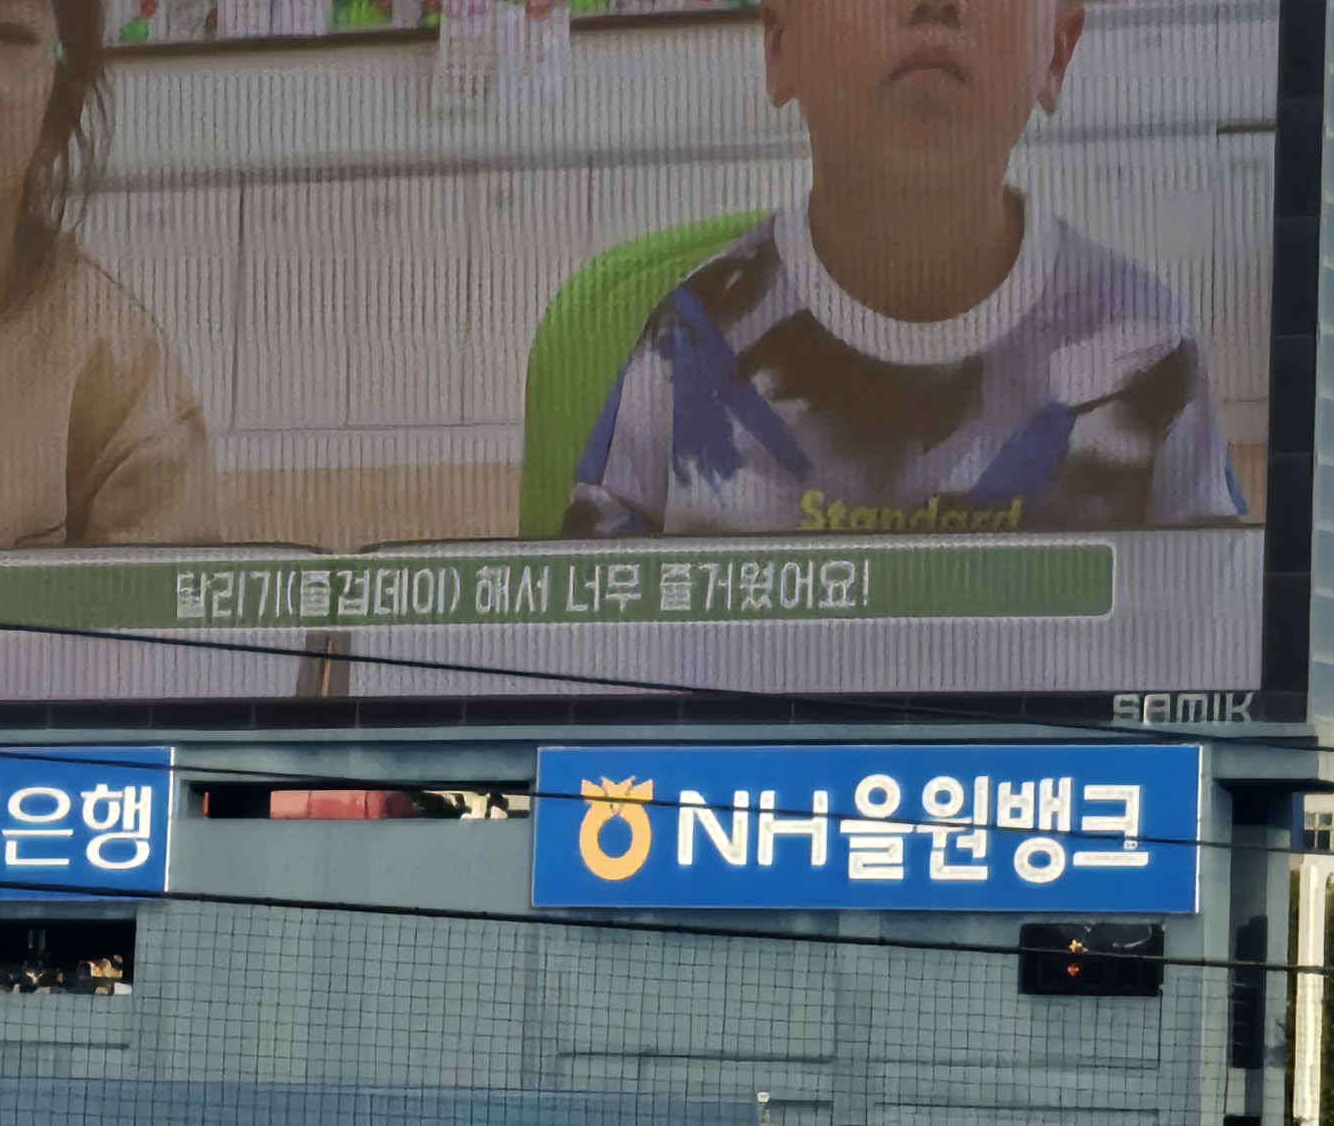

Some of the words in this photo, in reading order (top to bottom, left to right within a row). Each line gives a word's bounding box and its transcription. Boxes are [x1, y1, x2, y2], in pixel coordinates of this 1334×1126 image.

[475, 564, 550, 615] 해서
[566, 562, 644, 613] 너무
[660, 558, 871, 613] 즐거웠어요!
[1112, 691, 1254, 725] SAMIK
[677, 772, 1151, 885] NH올원뱅크
